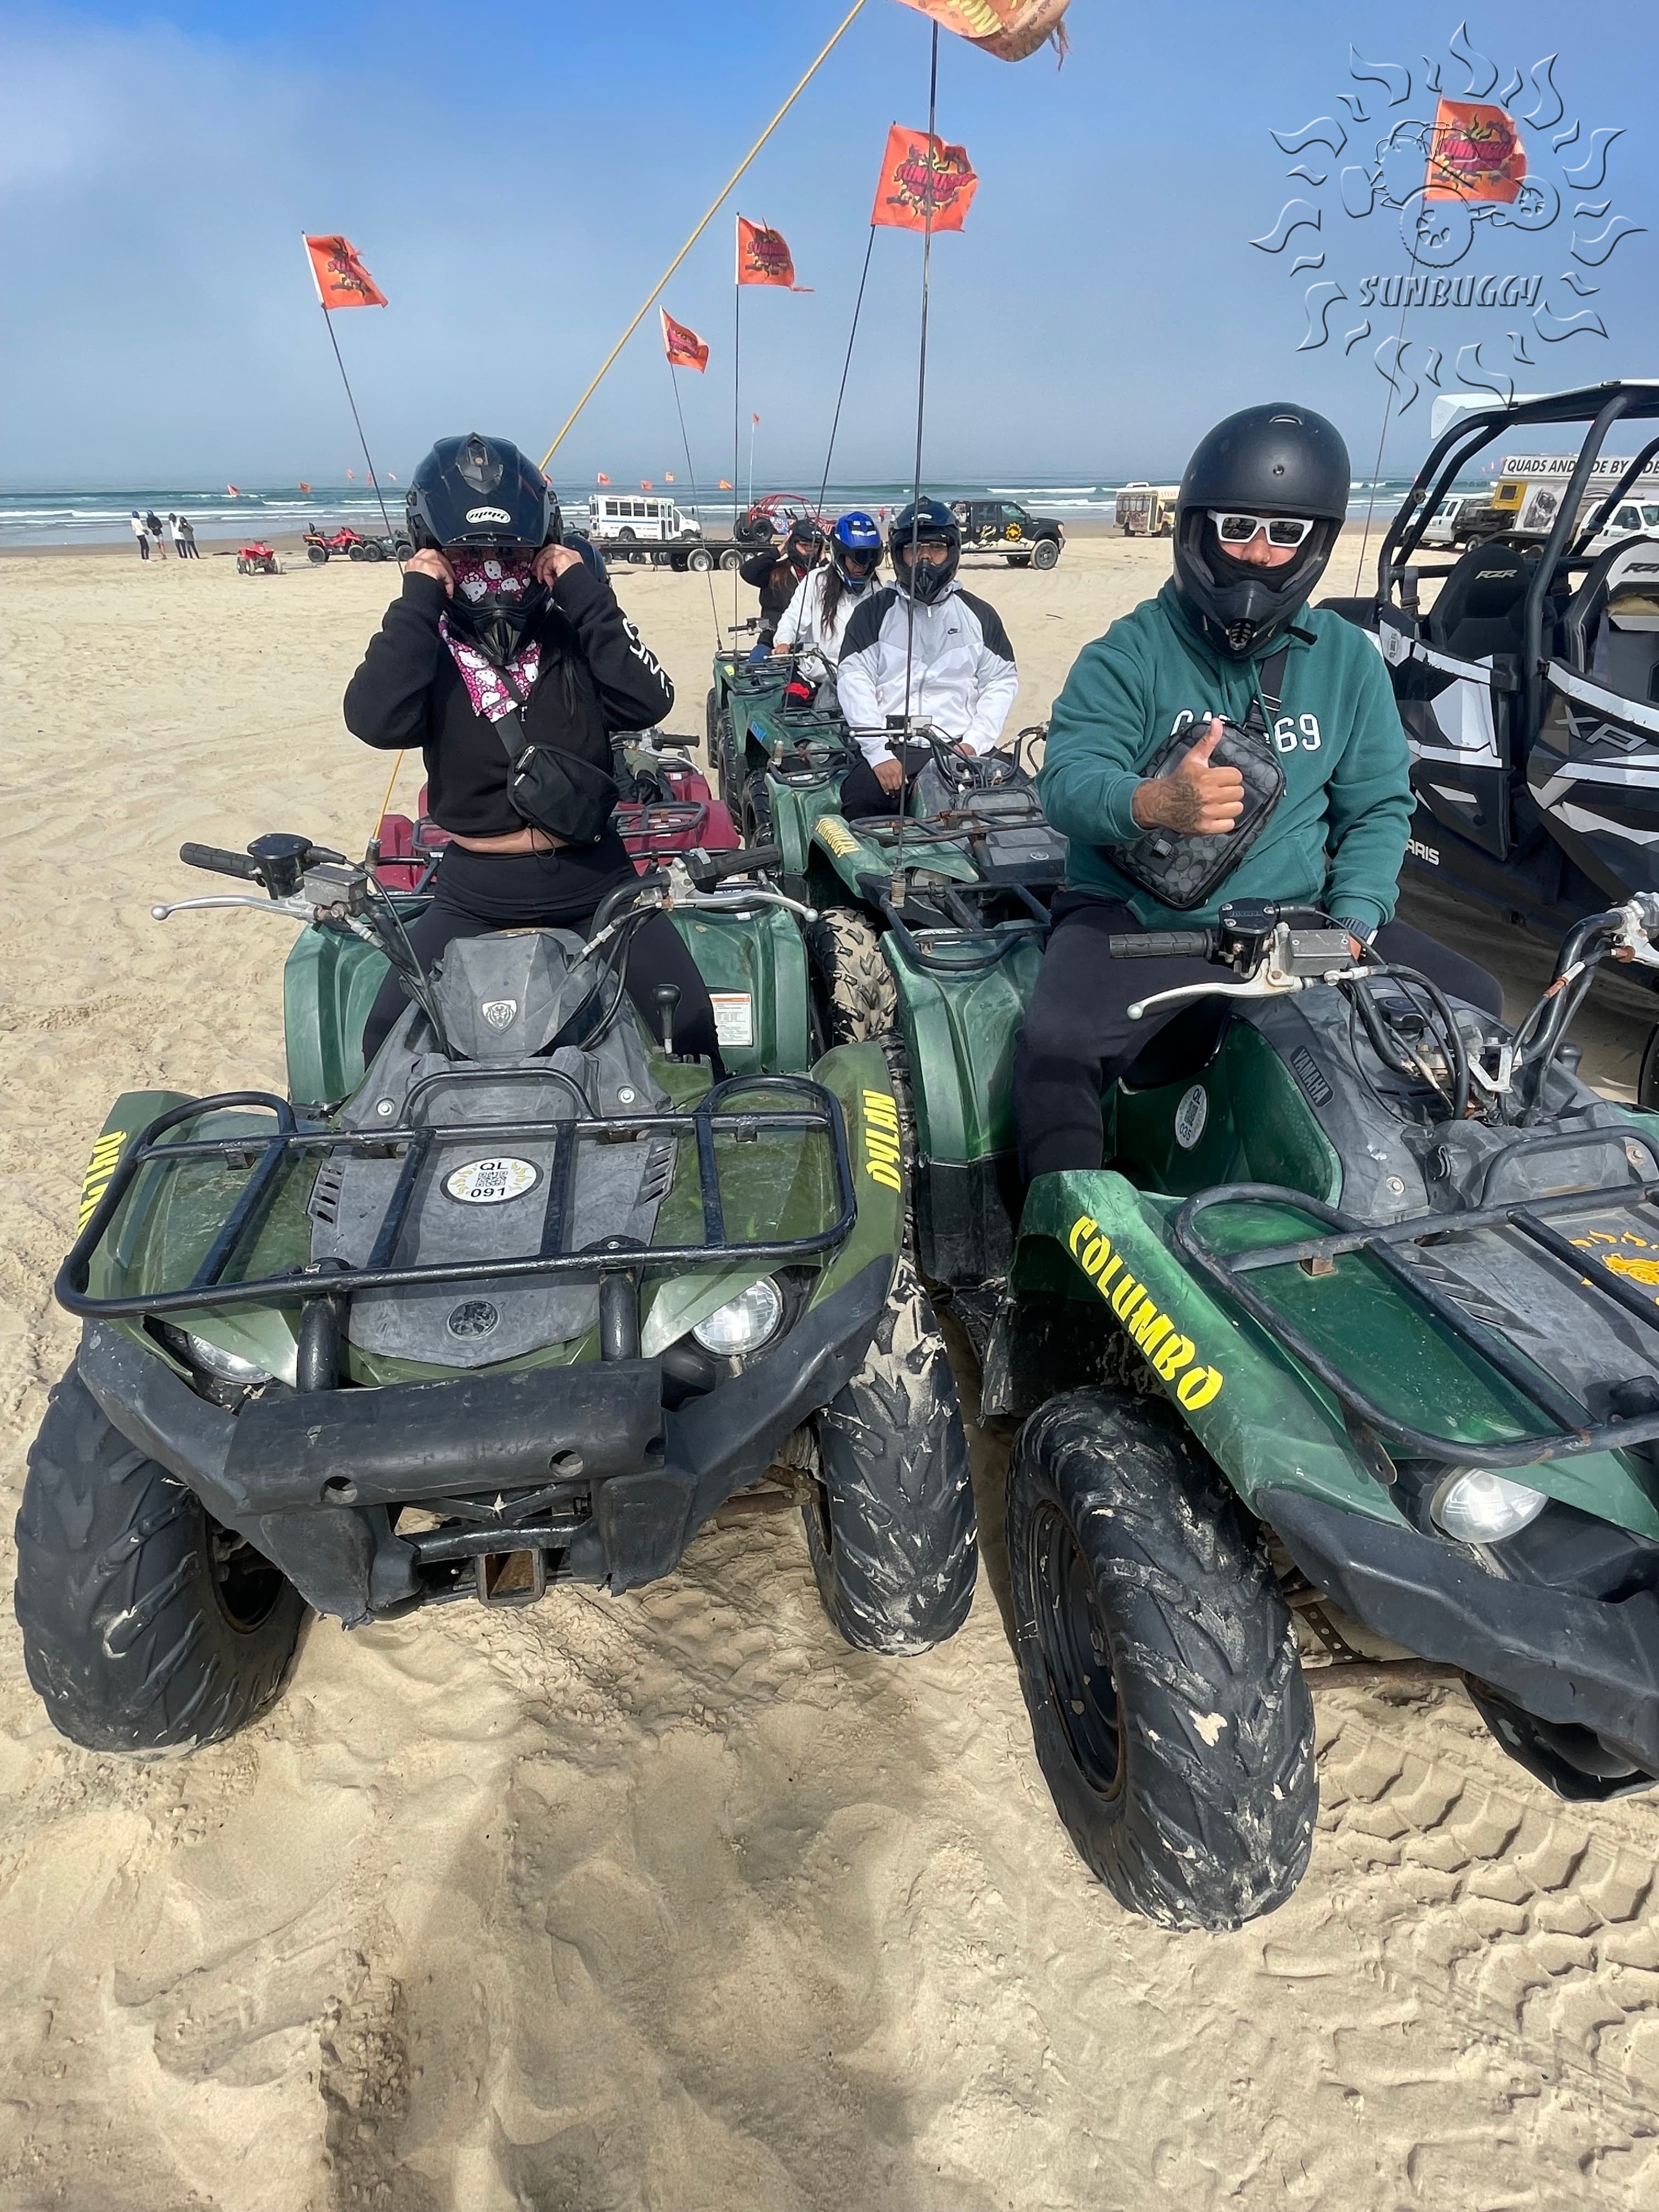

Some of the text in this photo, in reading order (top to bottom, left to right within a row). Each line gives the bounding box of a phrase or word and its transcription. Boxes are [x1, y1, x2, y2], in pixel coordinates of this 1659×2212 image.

[1508, 459, 1547, 473] QUADS
[1610, 460, 1629, 474] BY
[1475, 569, 1518, 580] RZR
[1554, 704, 1647, 753] XP
[1293, 1048, 1330, 1104] YAMAHA
[1179, 1122, 1192, 1142] 035
[479, 1162, 509, 1171] QL
[471, 1187, 505, 1198] 091
[1069, 1215, 1224, 1412] COLUMBO
